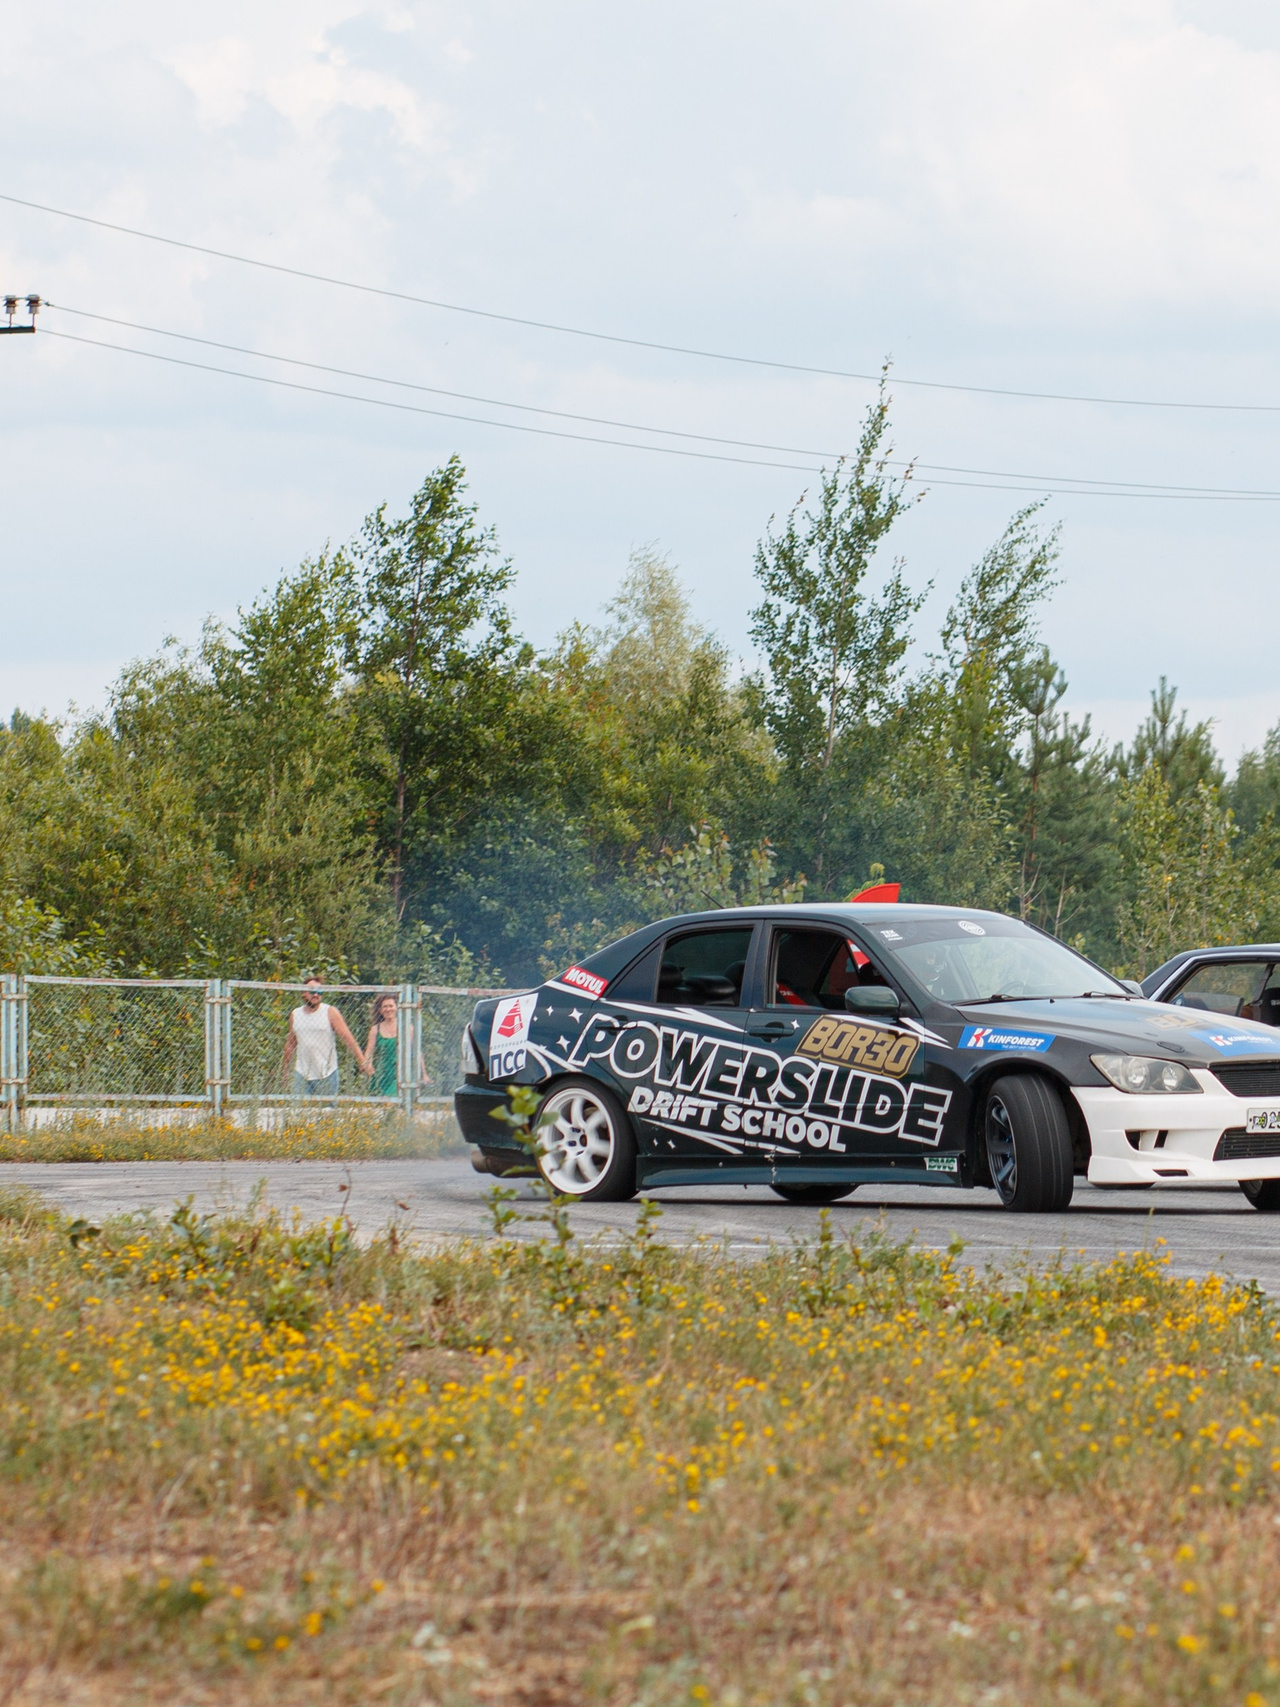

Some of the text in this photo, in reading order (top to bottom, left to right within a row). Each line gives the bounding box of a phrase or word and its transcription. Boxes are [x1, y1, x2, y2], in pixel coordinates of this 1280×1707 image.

[564, 967, 605, 995] MOTUL
[987, 1034, 1045, 1047] KINFOREST
[490, 1048, 525, 1079] ПСС
[565, 1012, 954, 1147] POWERSLIDE
[627, 1085, 847, 1153] DRIFT SCHOOL
